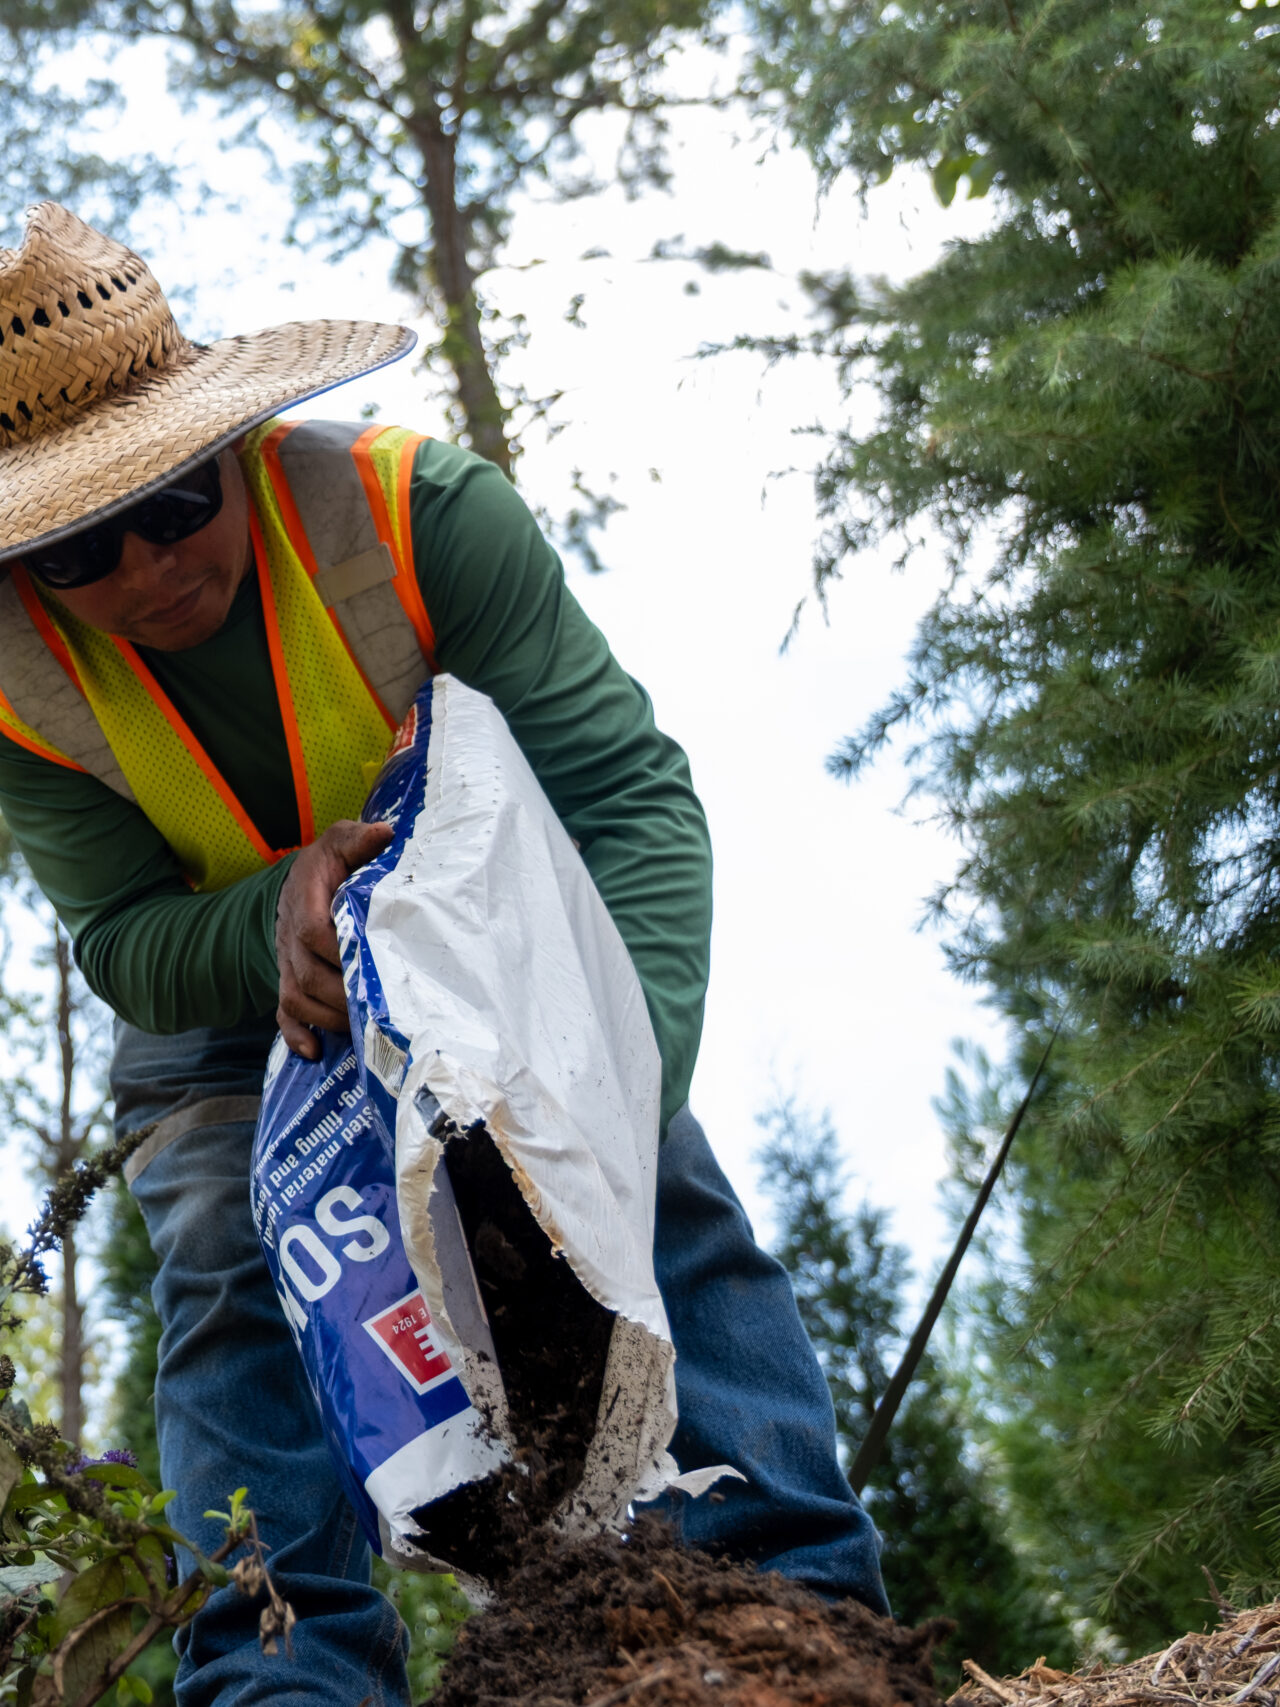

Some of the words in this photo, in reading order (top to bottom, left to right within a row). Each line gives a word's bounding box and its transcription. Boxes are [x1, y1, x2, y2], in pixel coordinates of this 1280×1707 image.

[313, 1076, 335, 1100] para
[294, 1110, 343, 1157] filling
[269, 1153, 299, 1188] and
[280, 1140, 341, 1207] material
[263, 1201, 283, 1250] ideal
[391, 1314, 417, 1335] 1924
